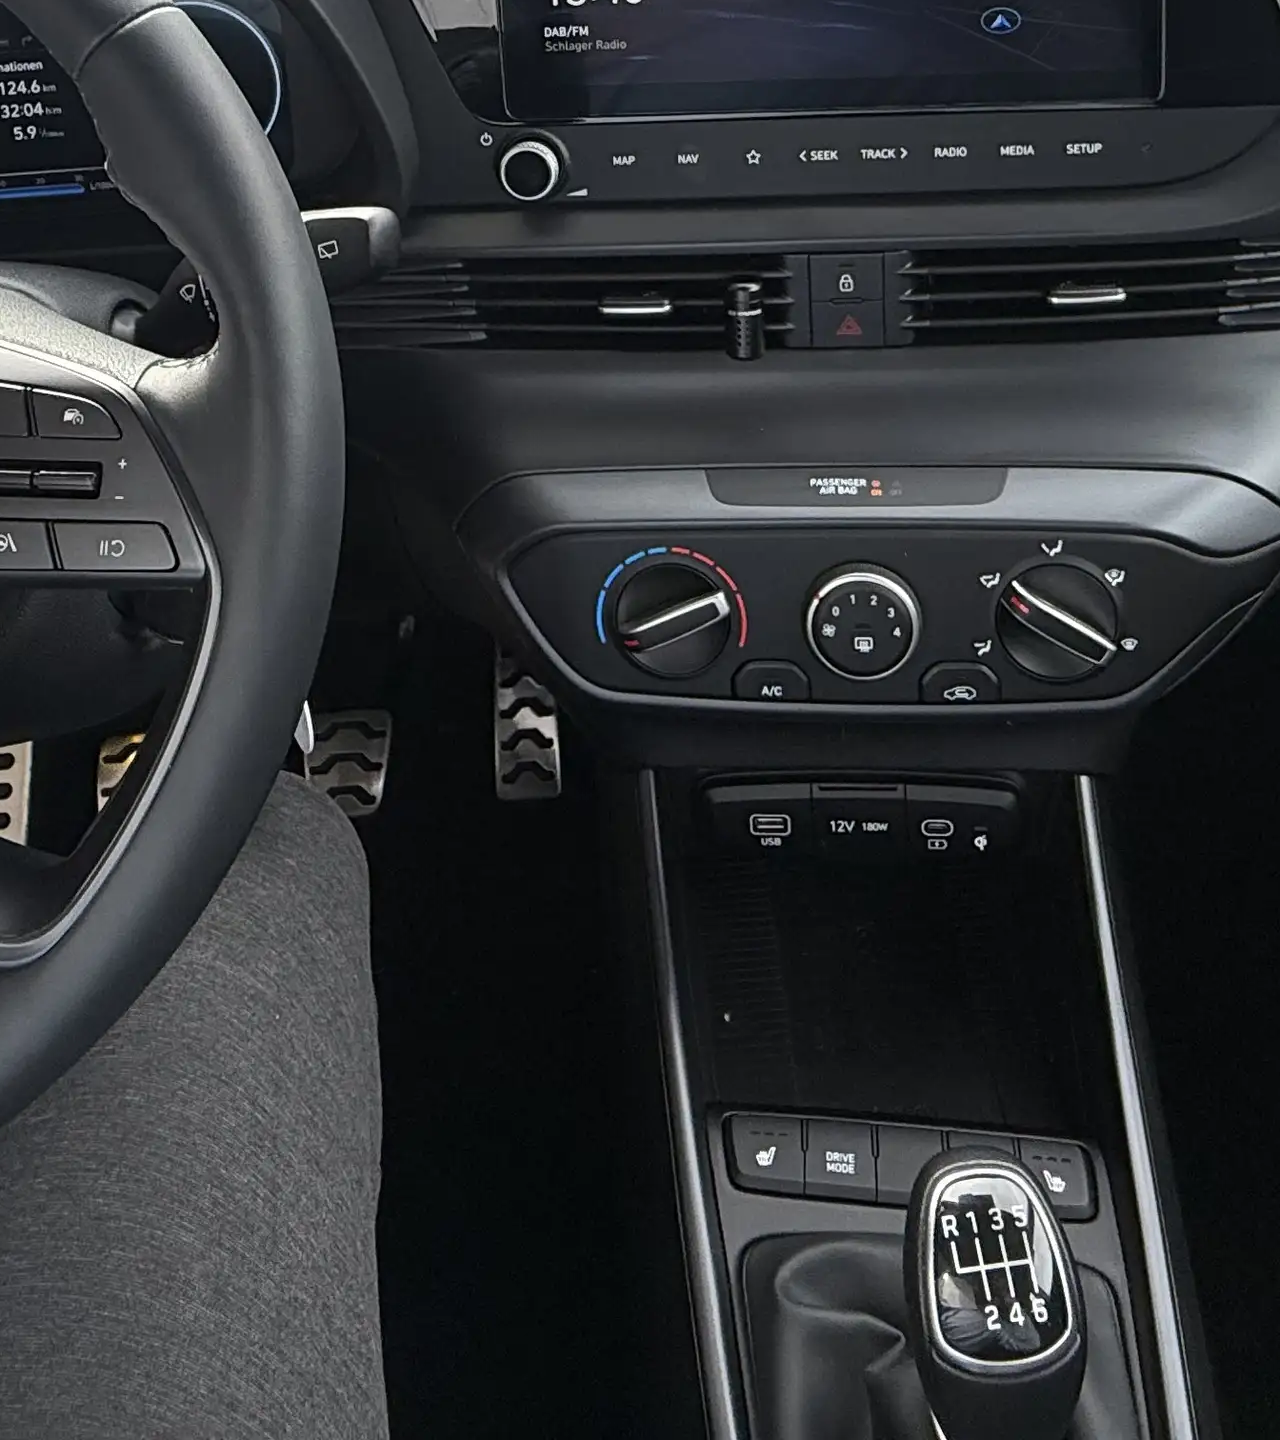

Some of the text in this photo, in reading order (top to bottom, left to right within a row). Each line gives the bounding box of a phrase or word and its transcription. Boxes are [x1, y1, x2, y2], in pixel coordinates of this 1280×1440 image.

[544, 25, 589, 38] DAB/FM
[545, 39, 627, 52] Schlager Radio
[13, 126, 37, 141] 5.9
[810, 150, 838, 161] SEEK
[860, 148, 896, 159] TRACK
[934, 146, 968, 158] RADIO
[1000, 145, 1034, 156] MEDIA
[1066, 143, 1102, 156] SETUP
[612, 156, 636, 166] MAP
[678, 154, 699, 164] NAV
[810, 478, 867, 488] PASSENGER
[819, 486, 836, 496] AIR
[832, 594, 902, 638] 0 1 2 3 4
[761, 685, 783, 696] A/C
[830, 820, 888, 834] 12V 180W
[761, 837, 782, 847] USB
[826, 1151, 856, 1164] DRIVE
[826, 1163, 856, 1175] MODE
[942, 1204, 1028, 1238] R 1 3 5
[986, 1298, 1048, 1330] 2 4 6
